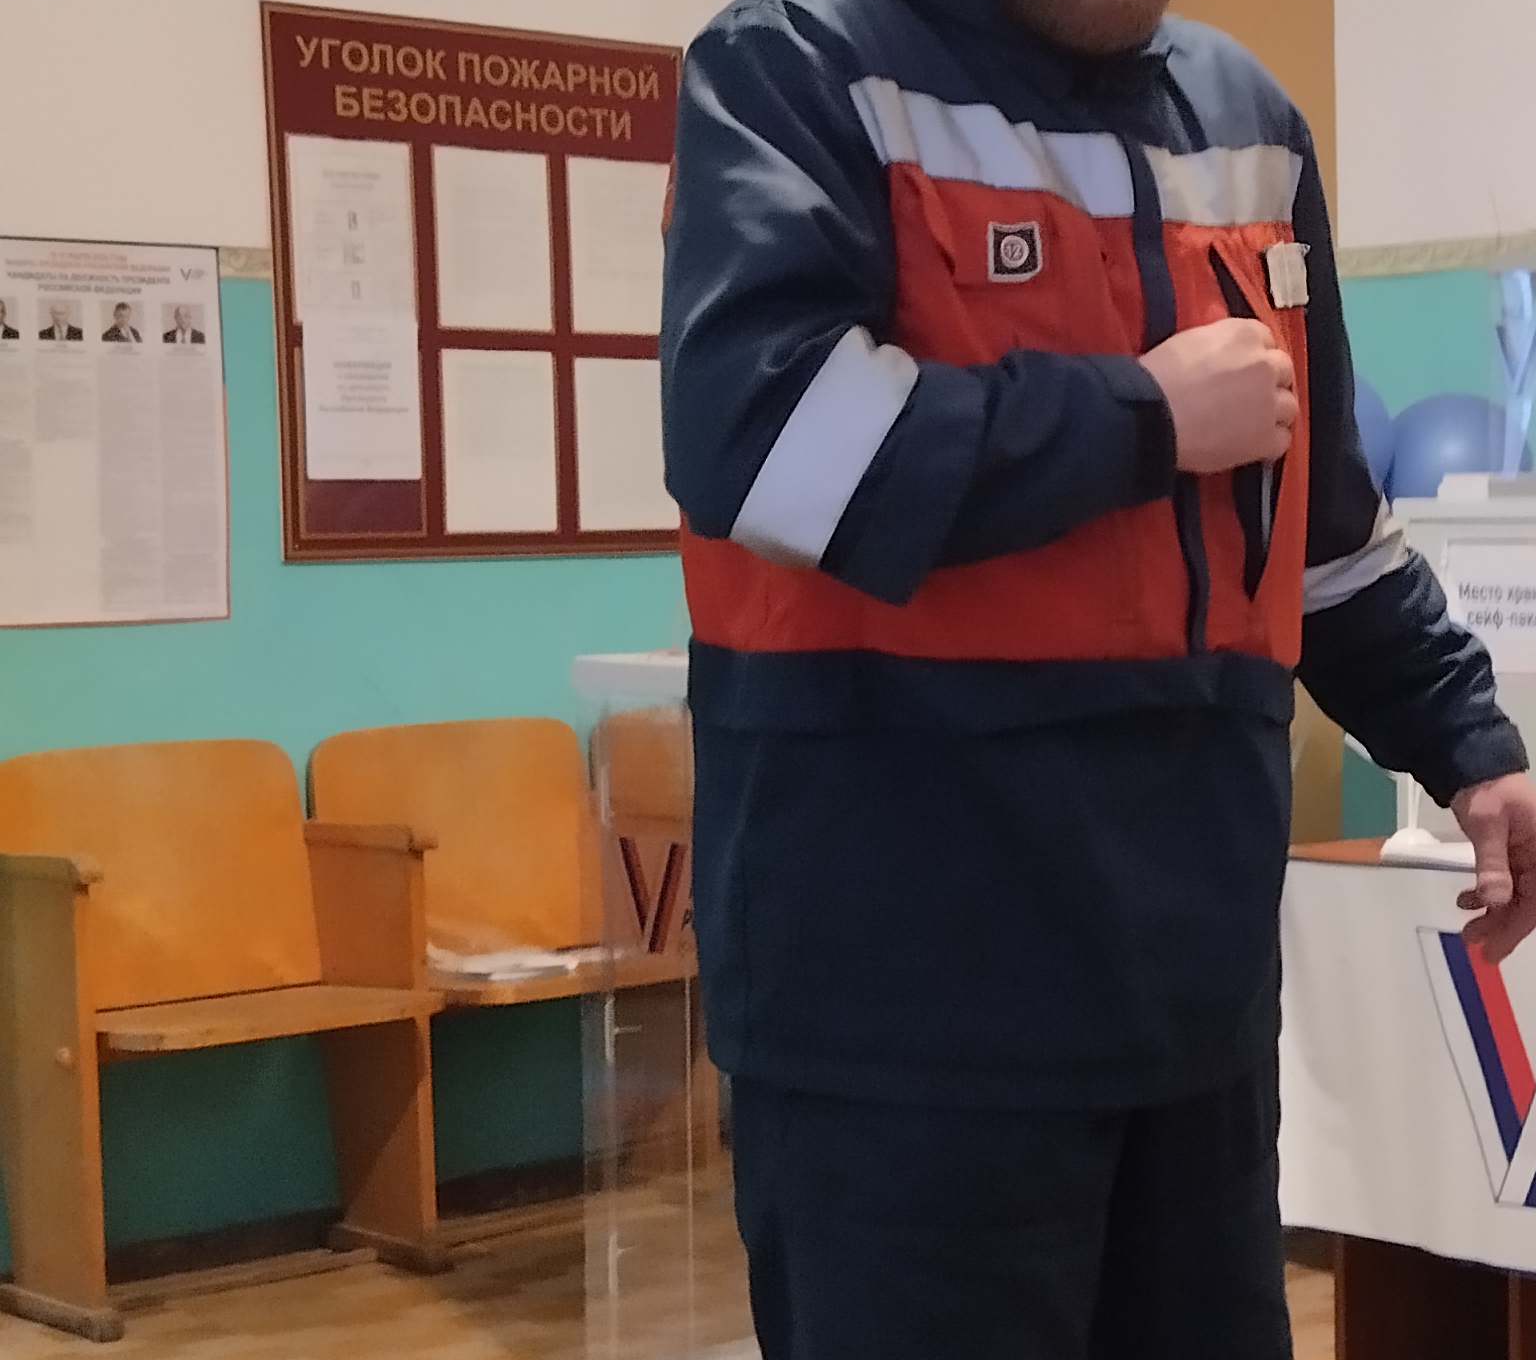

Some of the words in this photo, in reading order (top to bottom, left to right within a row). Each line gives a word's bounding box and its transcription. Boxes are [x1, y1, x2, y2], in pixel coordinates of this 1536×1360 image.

[295, 34, 447, 81] УГОЛОК
[456, 50, 661, 101] ПОЖАРНОЙ
[334, 83, 634, 141] БЕЗОПАСНОСТИ
[1458, 583, 1502, 601] Место
